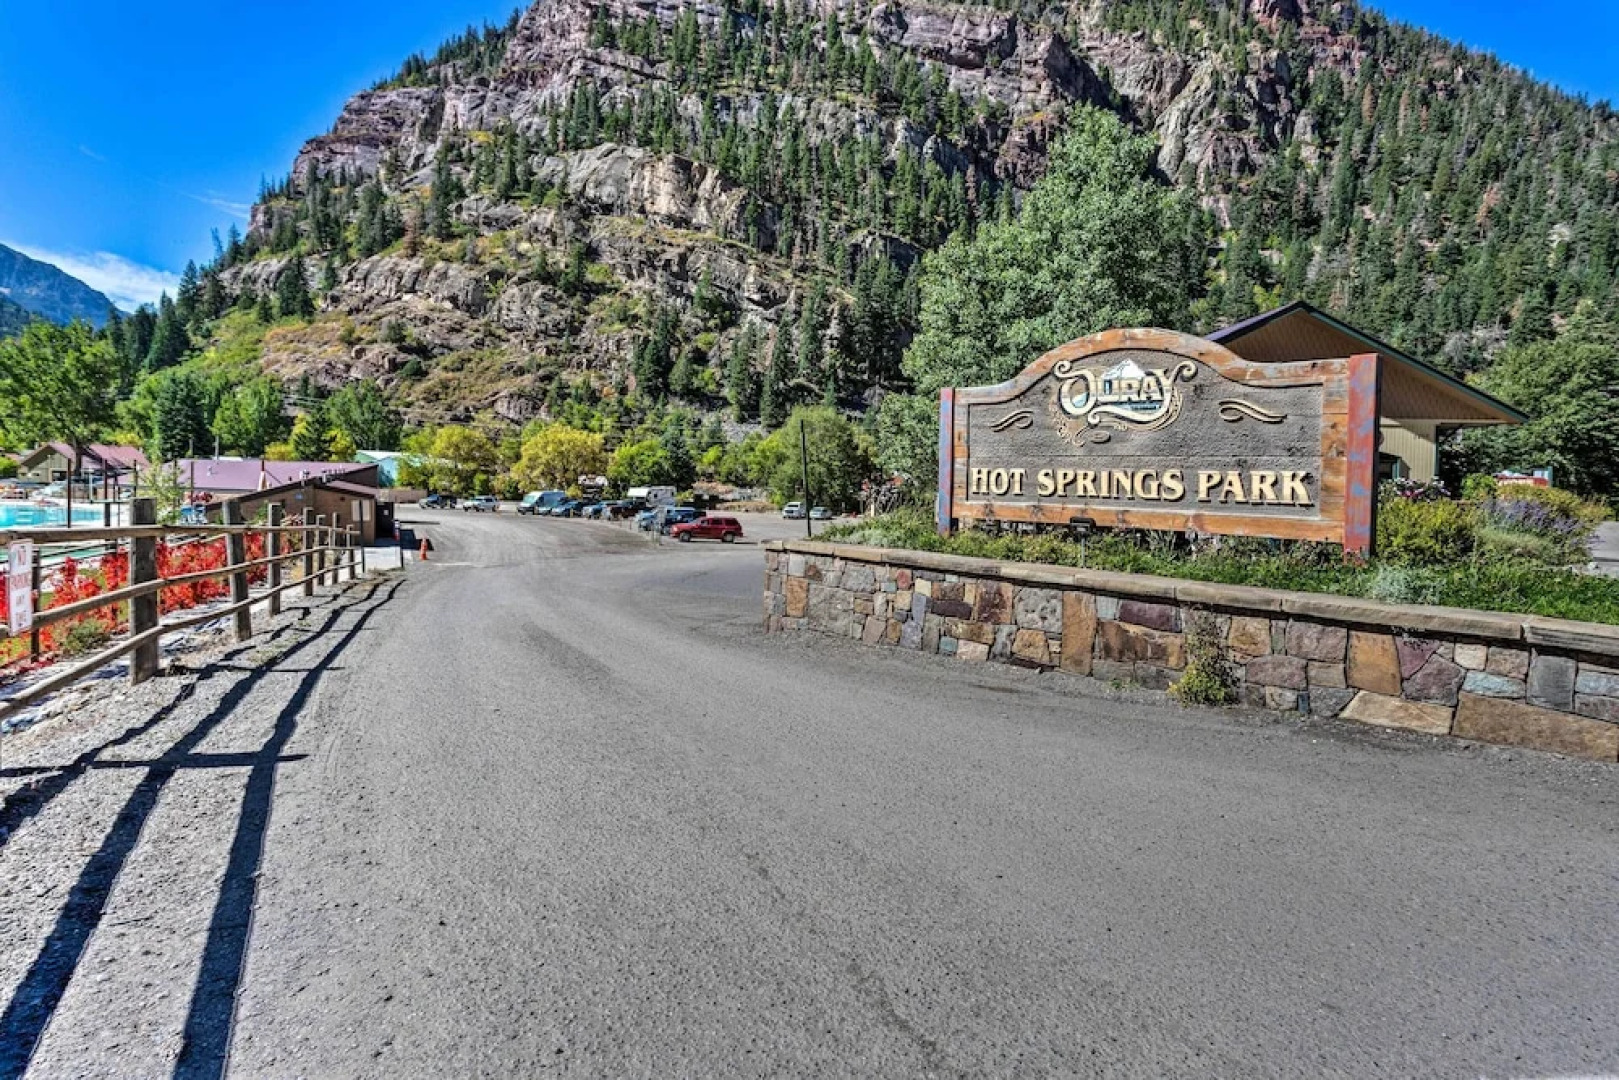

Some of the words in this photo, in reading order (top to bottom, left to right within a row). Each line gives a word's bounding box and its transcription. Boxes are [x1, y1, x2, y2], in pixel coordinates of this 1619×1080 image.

[1055, 361, 1197, 423] OURAY
[971, 467, 1026, 496] HOT
[1037, 469, 1184, 501] SPRINGS
[1198, 470, 1314, 506] PARK
